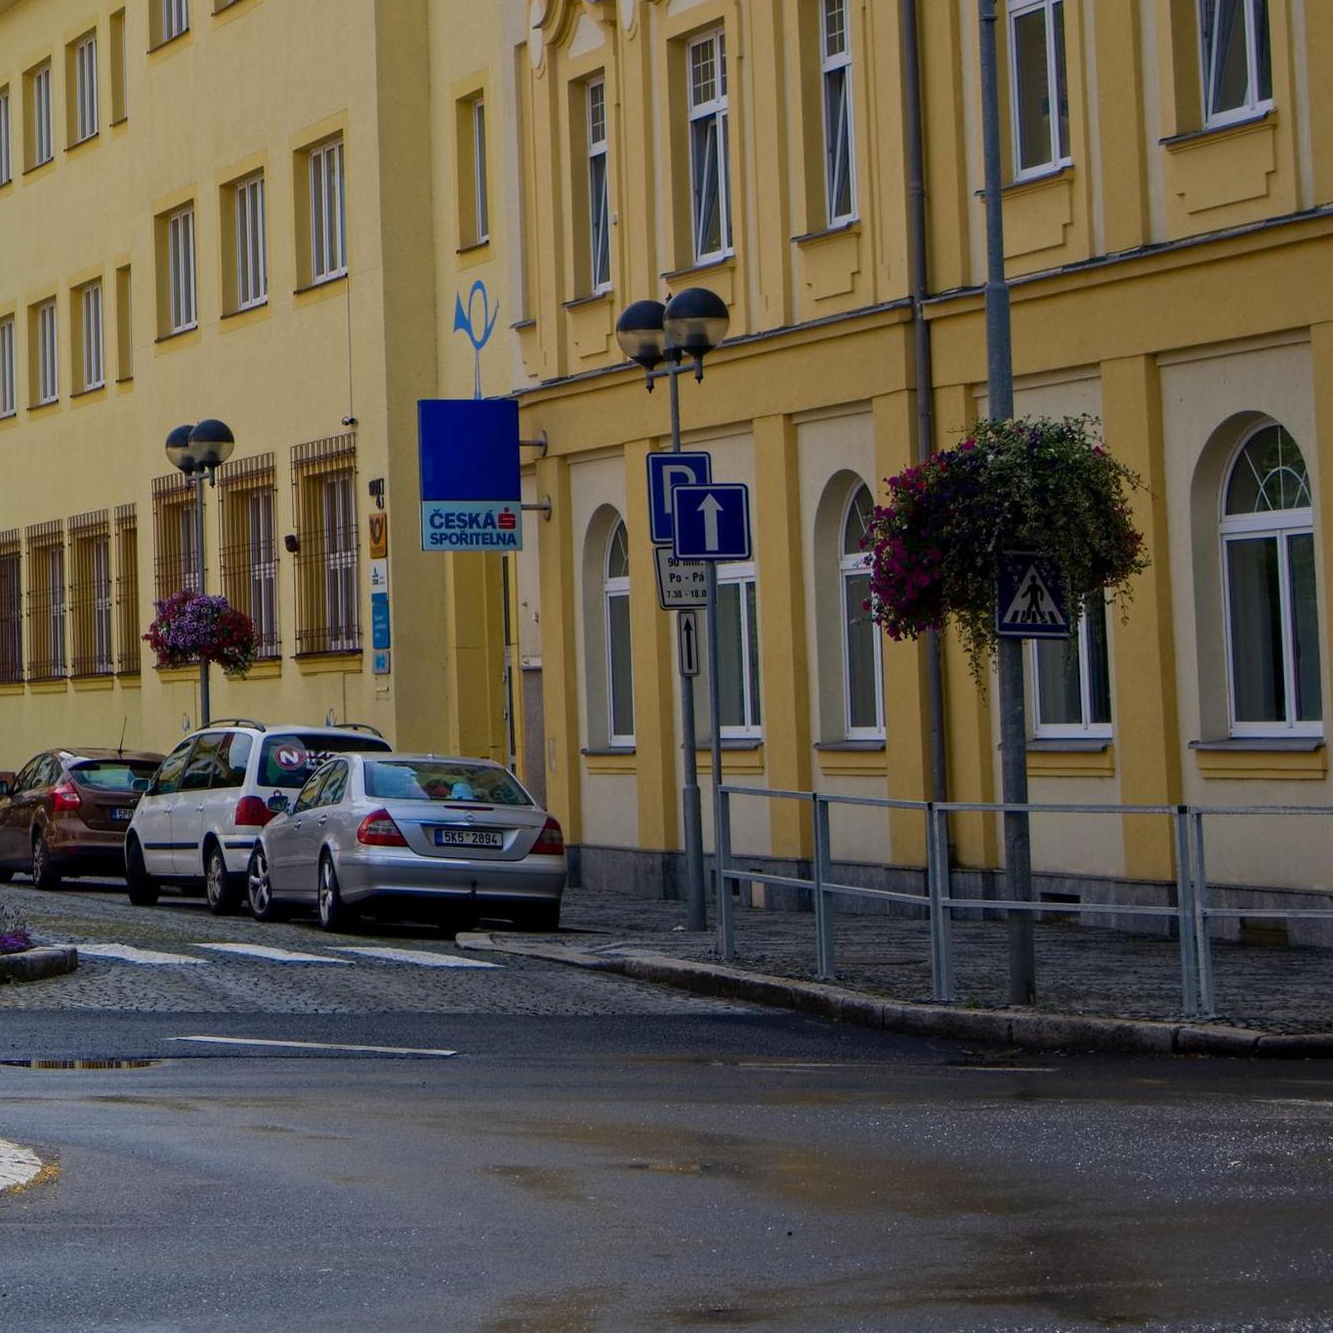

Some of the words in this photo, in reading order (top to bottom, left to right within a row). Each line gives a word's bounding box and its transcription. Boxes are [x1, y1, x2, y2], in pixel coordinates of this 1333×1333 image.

[429, 509, 497, 529] ČESKÁ
[430, 530, 517, 545] SPOŘITELNA
[669, 573, 682, 583] Po
[691, 589, 707, 598] 18.0
[444, 831, 465, 844] 5K5
[472, 832, 498, 844] 2894
